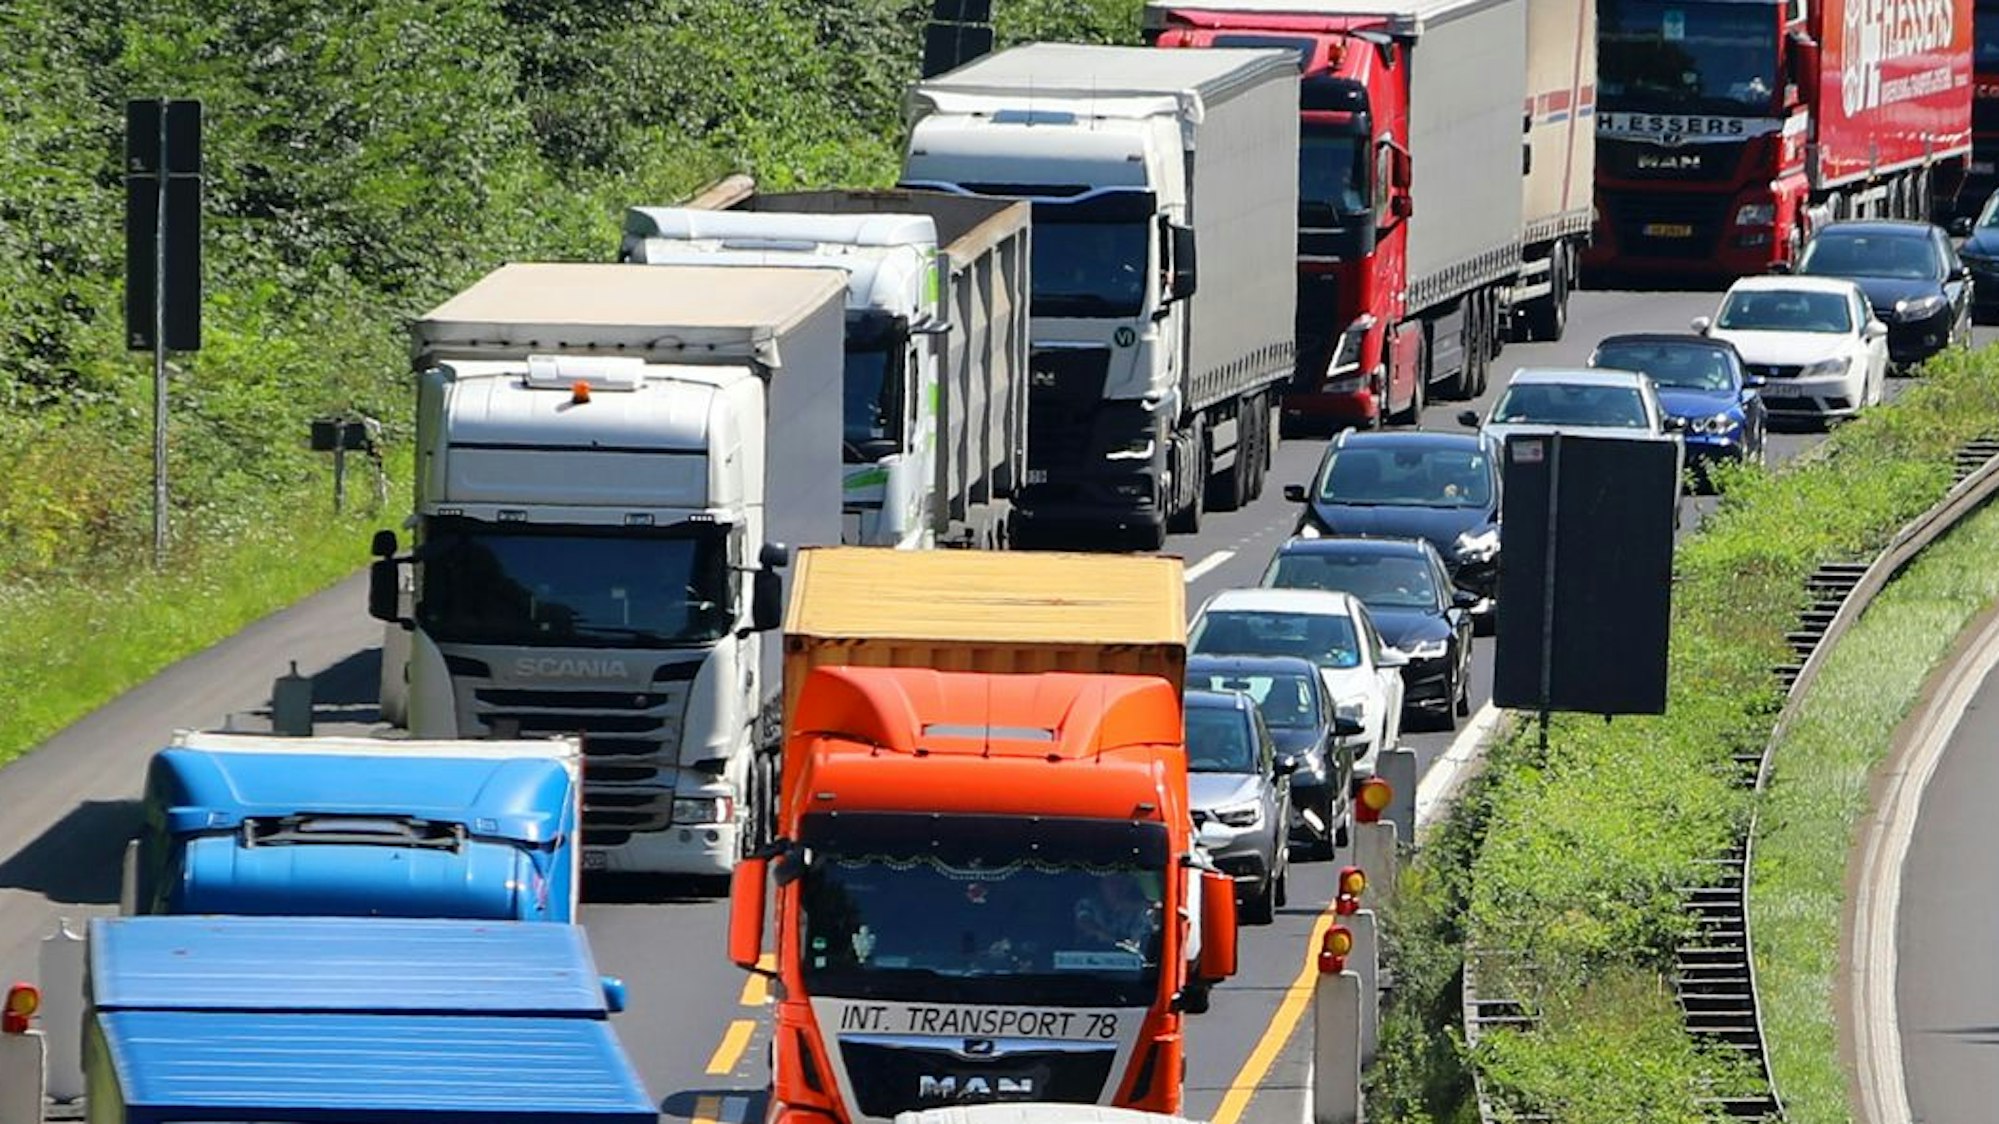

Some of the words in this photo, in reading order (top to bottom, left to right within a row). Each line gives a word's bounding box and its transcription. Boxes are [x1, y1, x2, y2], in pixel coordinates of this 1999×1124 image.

[1598, 114, 1744, 134] H.ESSERS
[1637, 154, 1701, 169] MAN
[517, 658, 628, 677] SCANIA
[840, 1005, 890, 1031] INT.
[907, 1007, 1076, 1036] TRANSPORT
[1085, 1013, 1119, 1039] 78
[918, 1074, 1033, 1099] MAN
